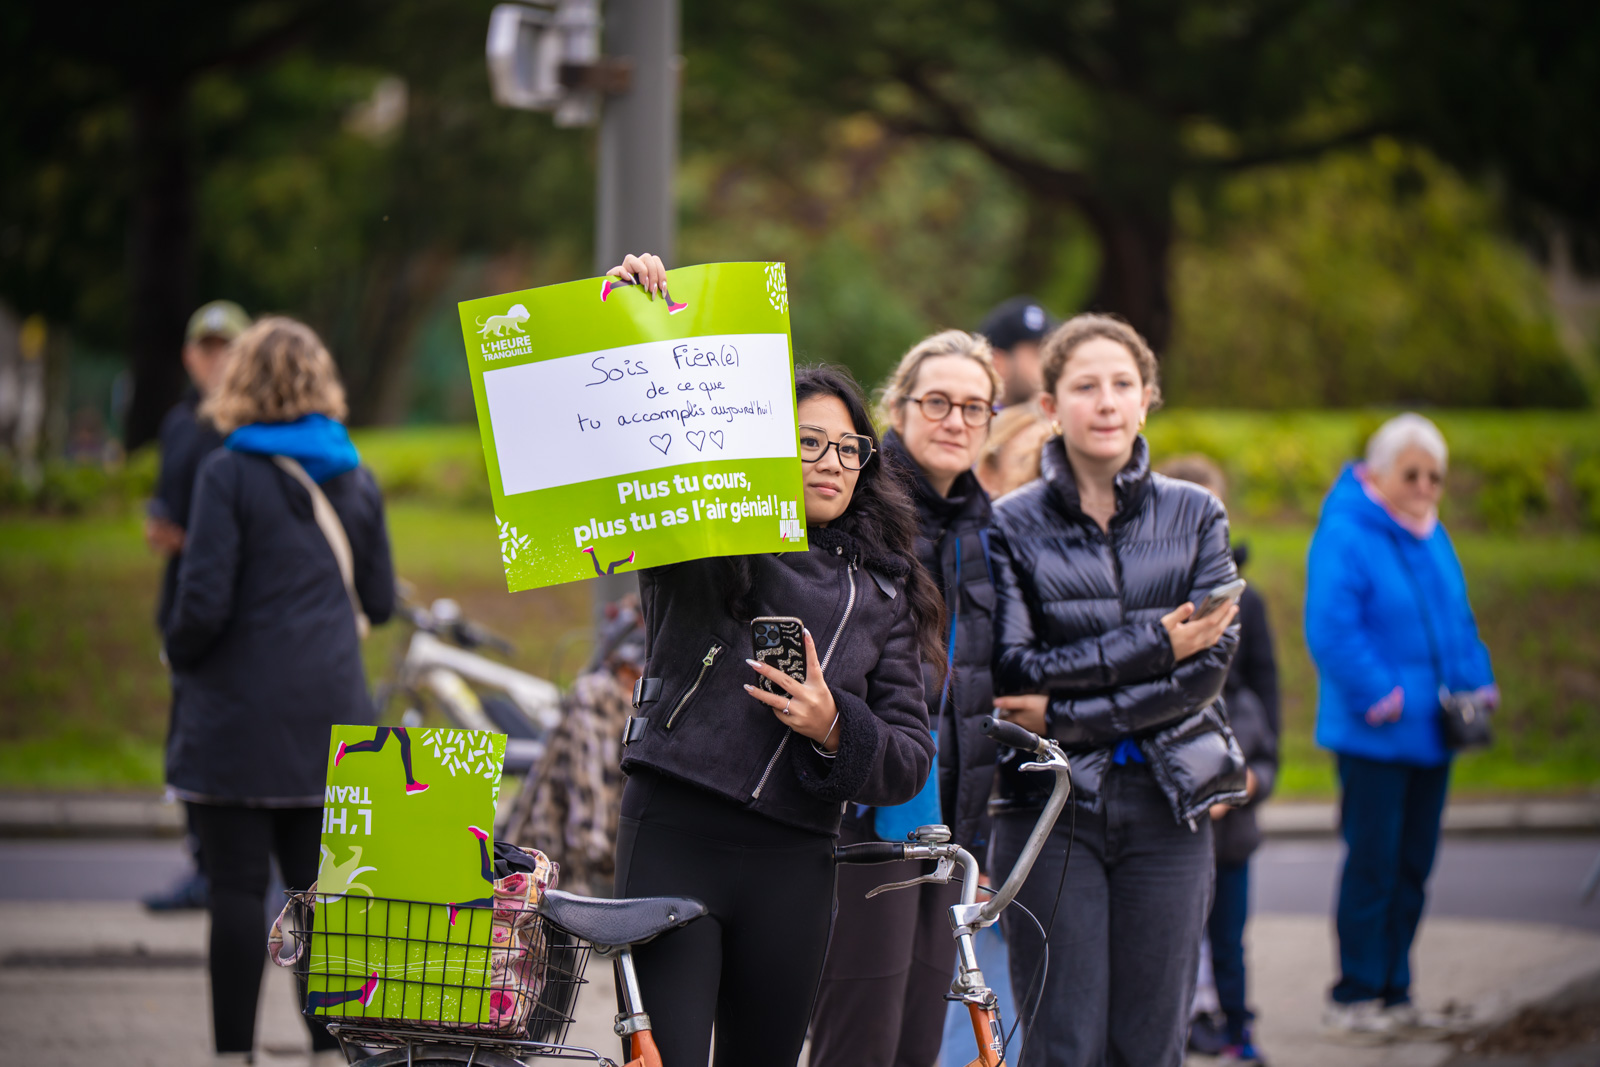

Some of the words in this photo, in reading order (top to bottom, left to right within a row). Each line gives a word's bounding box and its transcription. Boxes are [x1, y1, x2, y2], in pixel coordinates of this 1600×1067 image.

[480, 335, 531, 354] L'HEURE
[483, 346, 533, 361] TRANQUILLE
[585, 356, 649, 387] Sois
[646, 381, 669, 399] de
[677, 381, 695, 391] ce
[699, 381, 726, 400] que
[577, 413, 601, 432] tu
[617, 400, 705, 426] accomplis
[617, 479, 671, 504] Plus
[673, 473, 700, 494] tu
[702, 471, 752, 492] cours,
[573, 517, 627, 548] plus
[629, 511, 657, 532] tu
[660, 506, 689, 527] as
[691, 496, 729, 522] l'air
